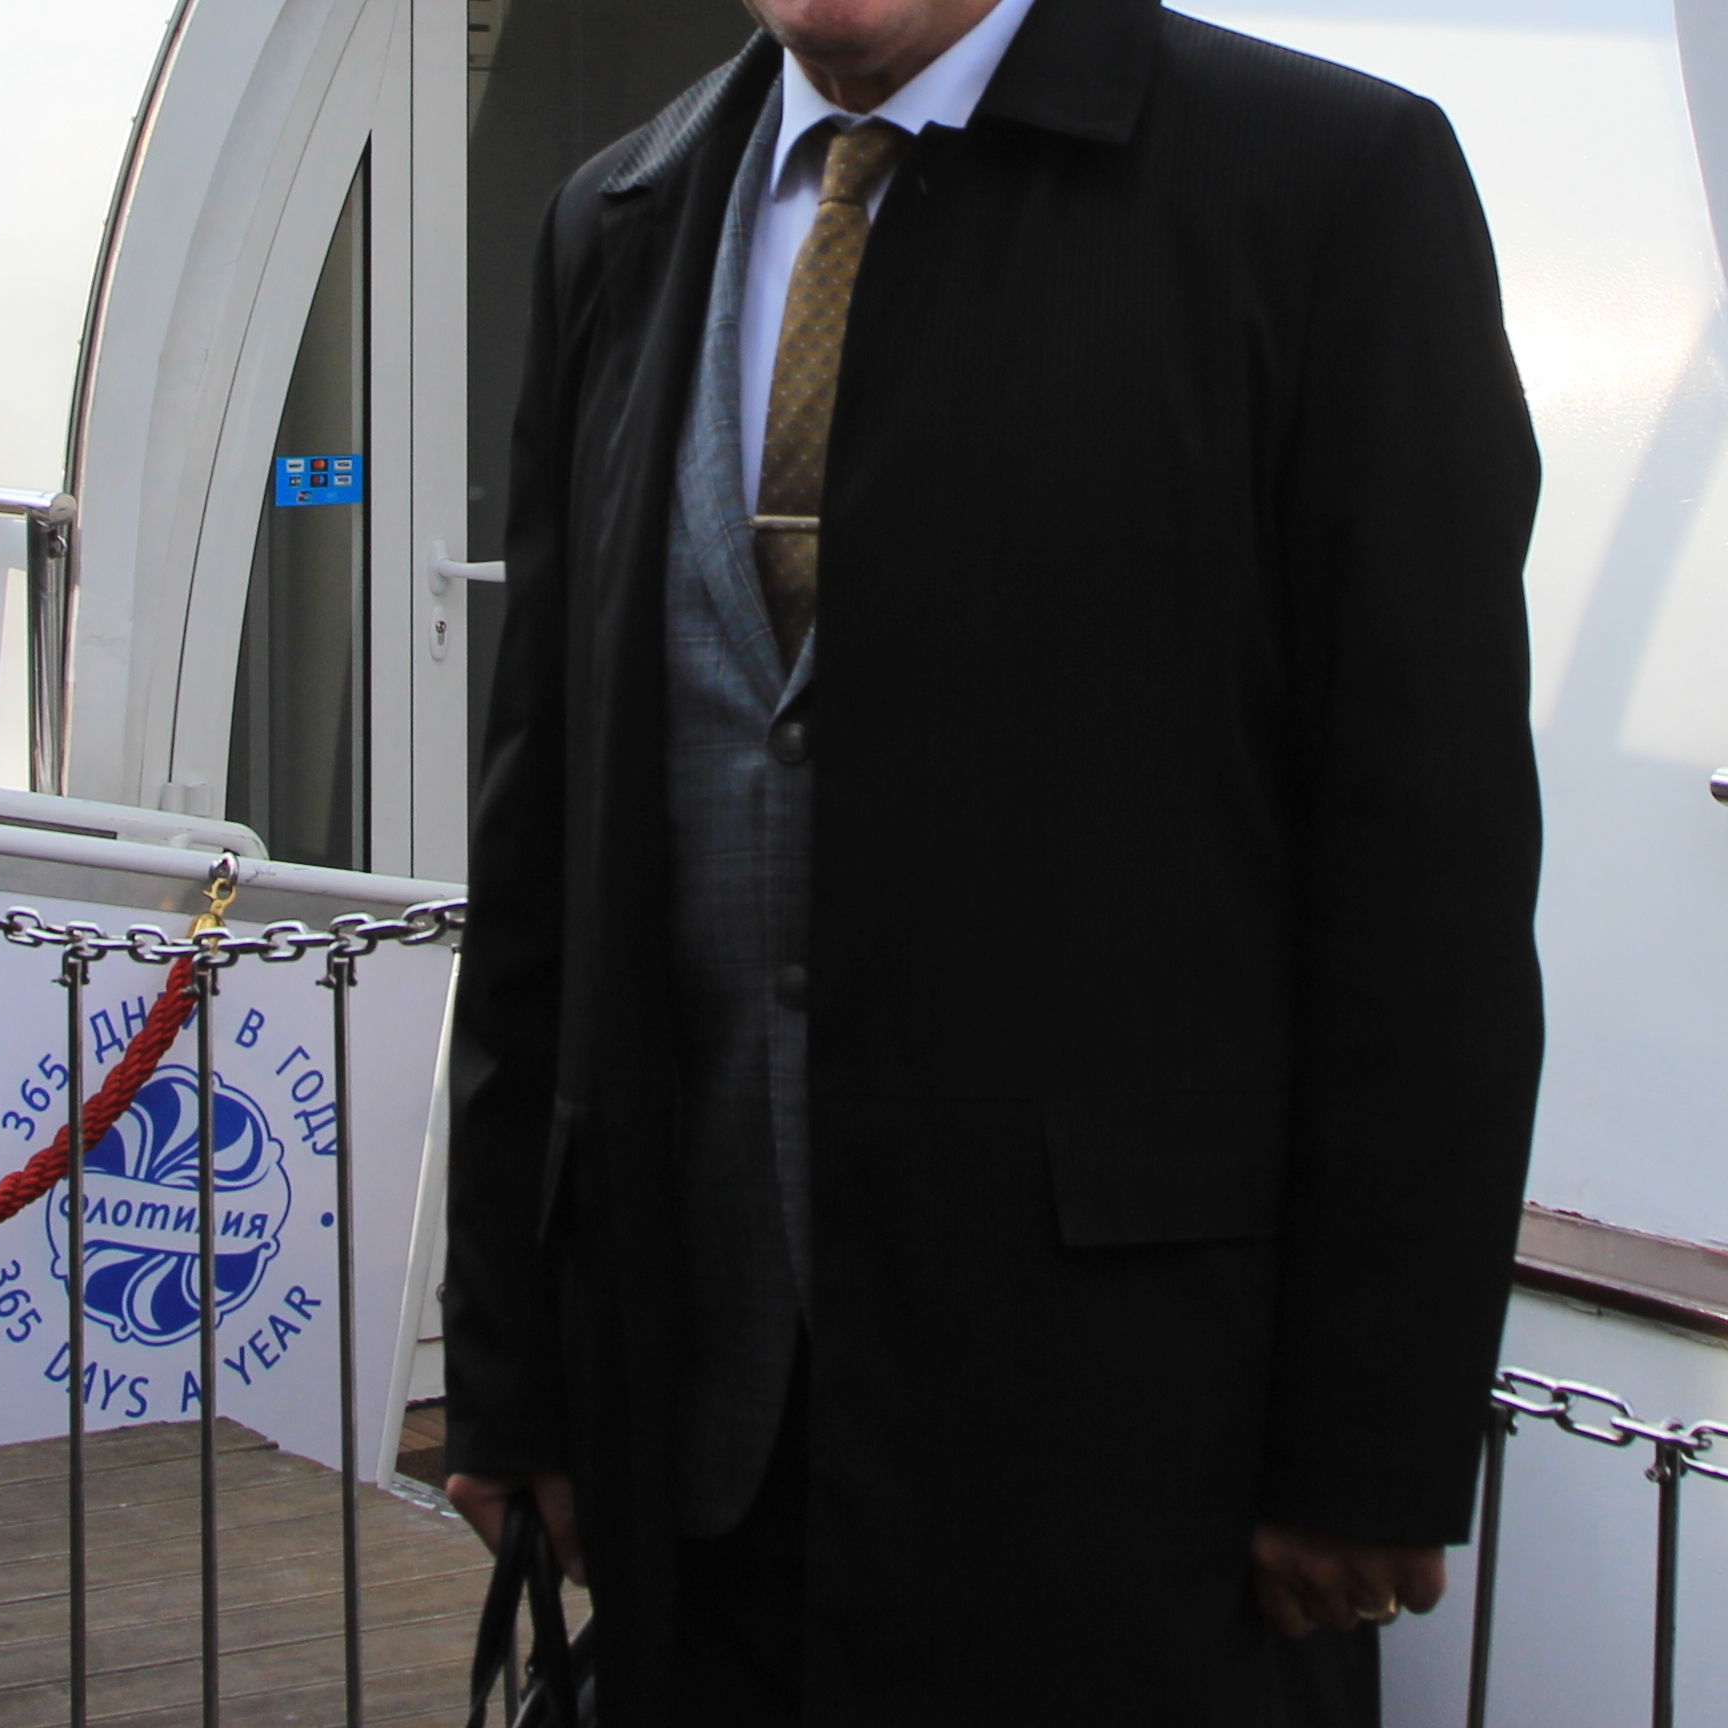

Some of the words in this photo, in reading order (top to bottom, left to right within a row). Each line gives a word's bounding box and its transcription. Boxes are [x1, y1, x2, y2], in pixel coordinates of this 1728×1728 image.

[1, 1053, 70, 1142] 365
[235, 1007, 266, 1049] В
[43, 1340, 150, 1419] DAYS
[223, 1284, 322, 1387] YEAR
